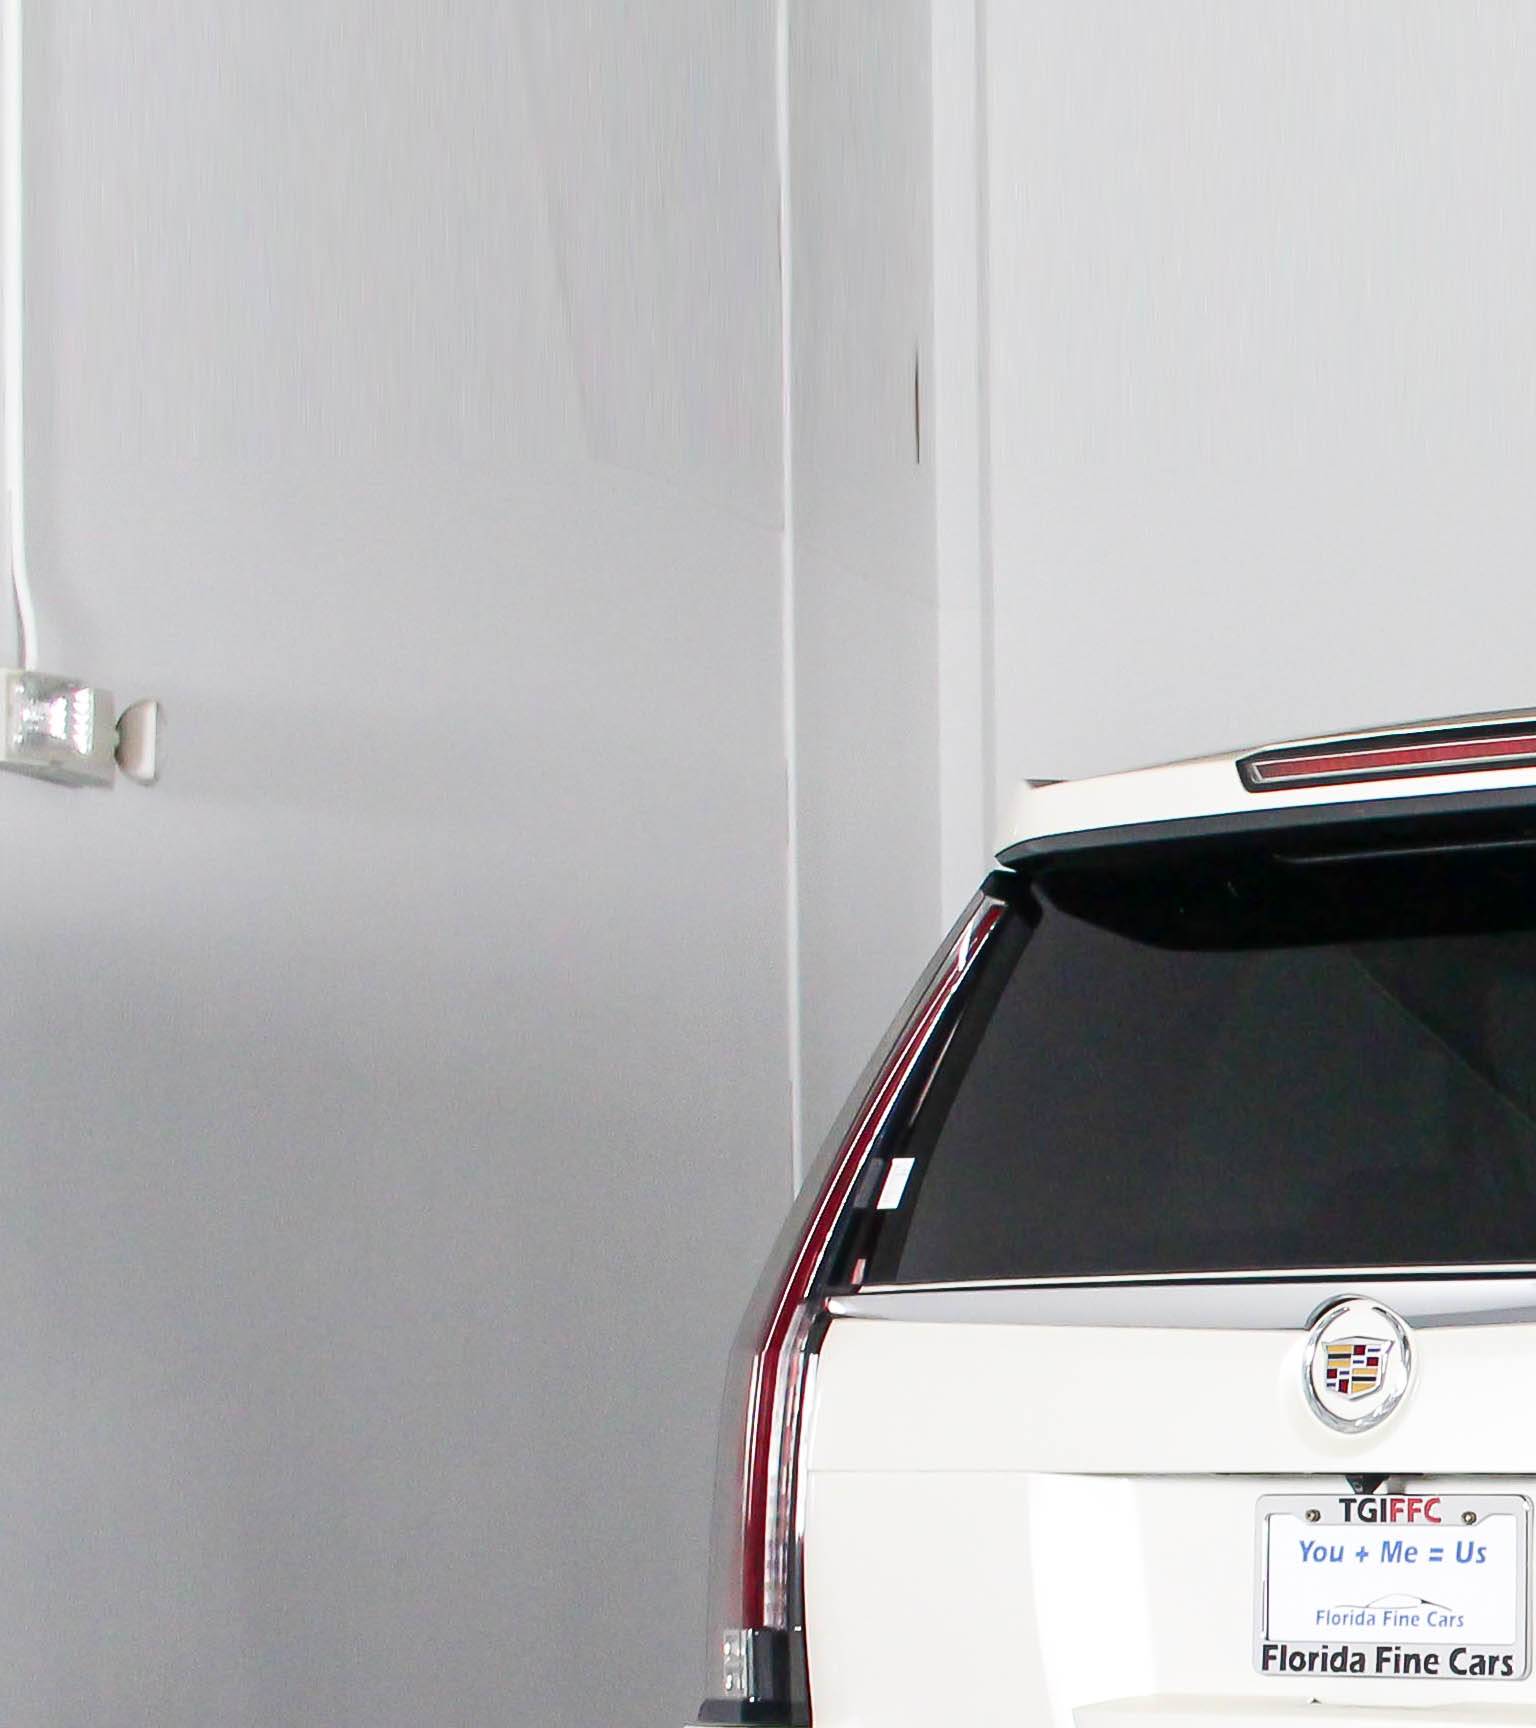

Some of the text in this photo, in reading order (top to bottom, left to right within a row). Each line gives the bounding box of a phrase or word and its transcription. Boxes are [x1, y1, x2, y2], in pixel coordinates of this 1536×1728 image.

[1338, 1497, 1442, 1523] TGIFFC
[1299, 1540, 1345, 1563] You
[1380, 1541, 1419, 1563] Me
[1455, 1541, 1487, 1564] Us
[1315, 1610, 1465, 1628] Florida Fine Cars
[1261, 1644, 1514, 1676] Florida Fine Cars
